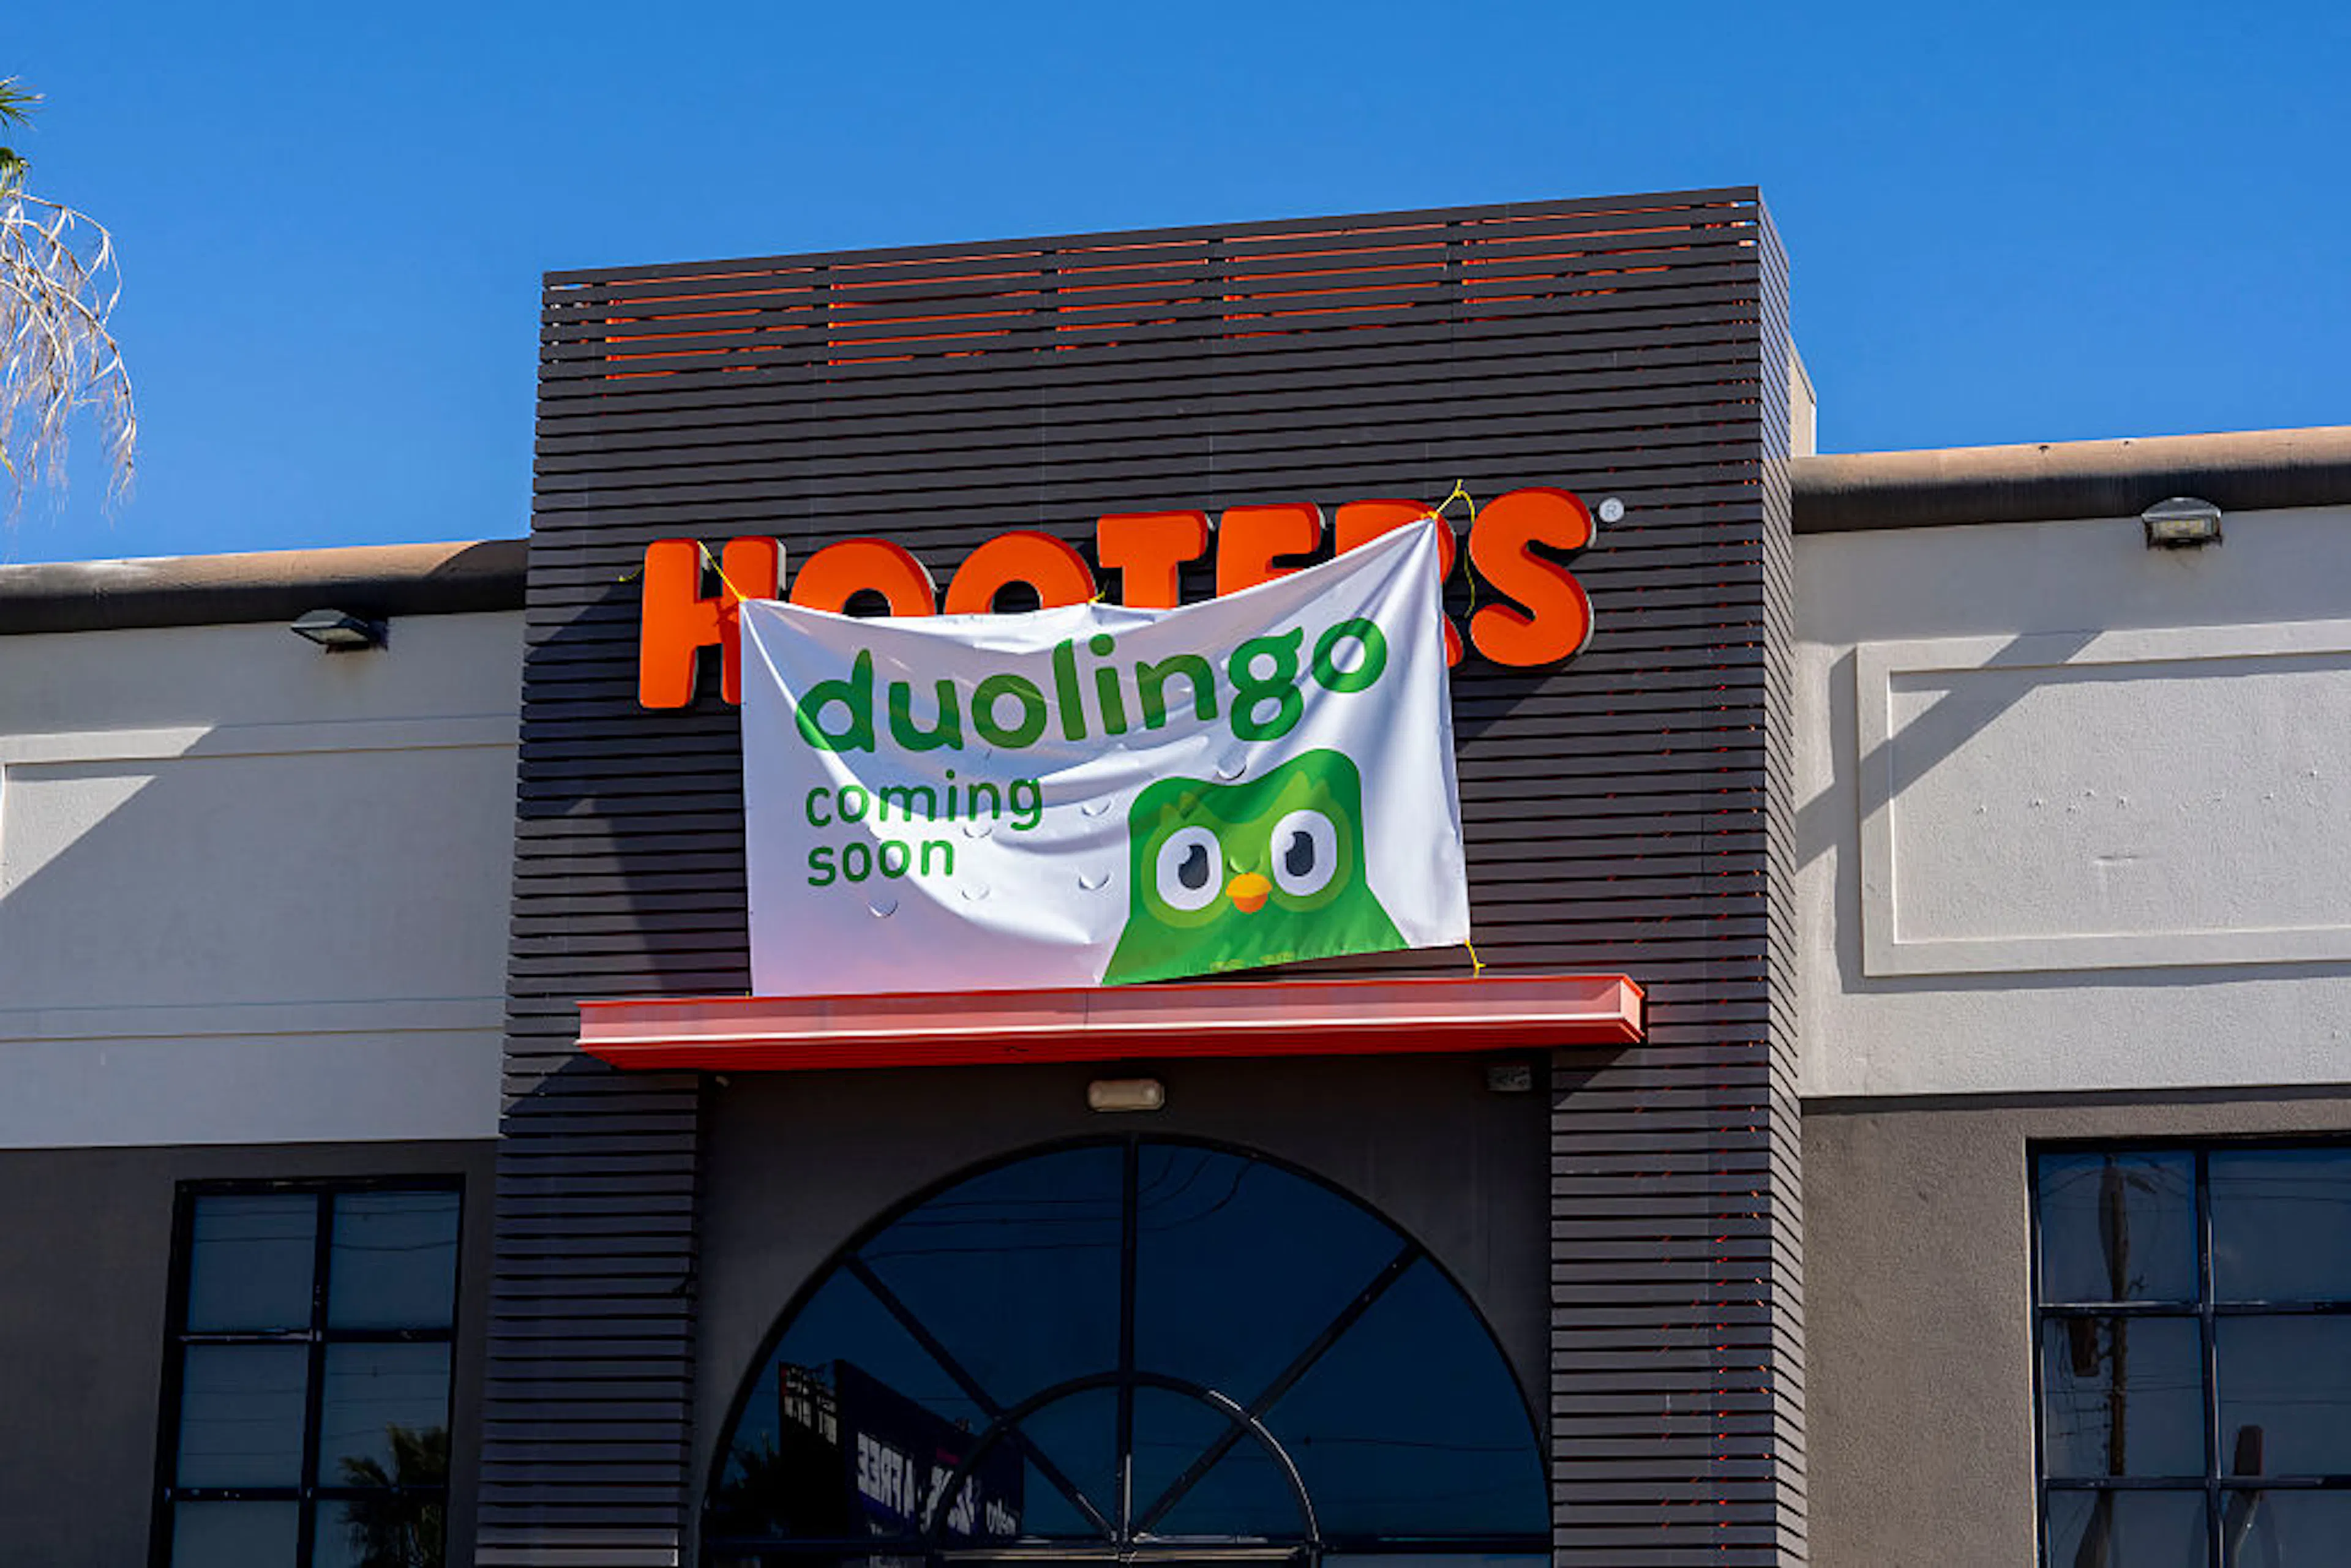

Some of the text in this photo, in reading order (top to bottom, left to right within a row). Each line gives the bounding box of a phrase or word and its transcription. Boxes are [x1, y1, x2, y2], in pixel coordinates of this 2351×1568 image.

[796, 618, 1387, 752] duolingo
[805, 769, 1042, 831] coming
[808, 839, 954, 887] soon
